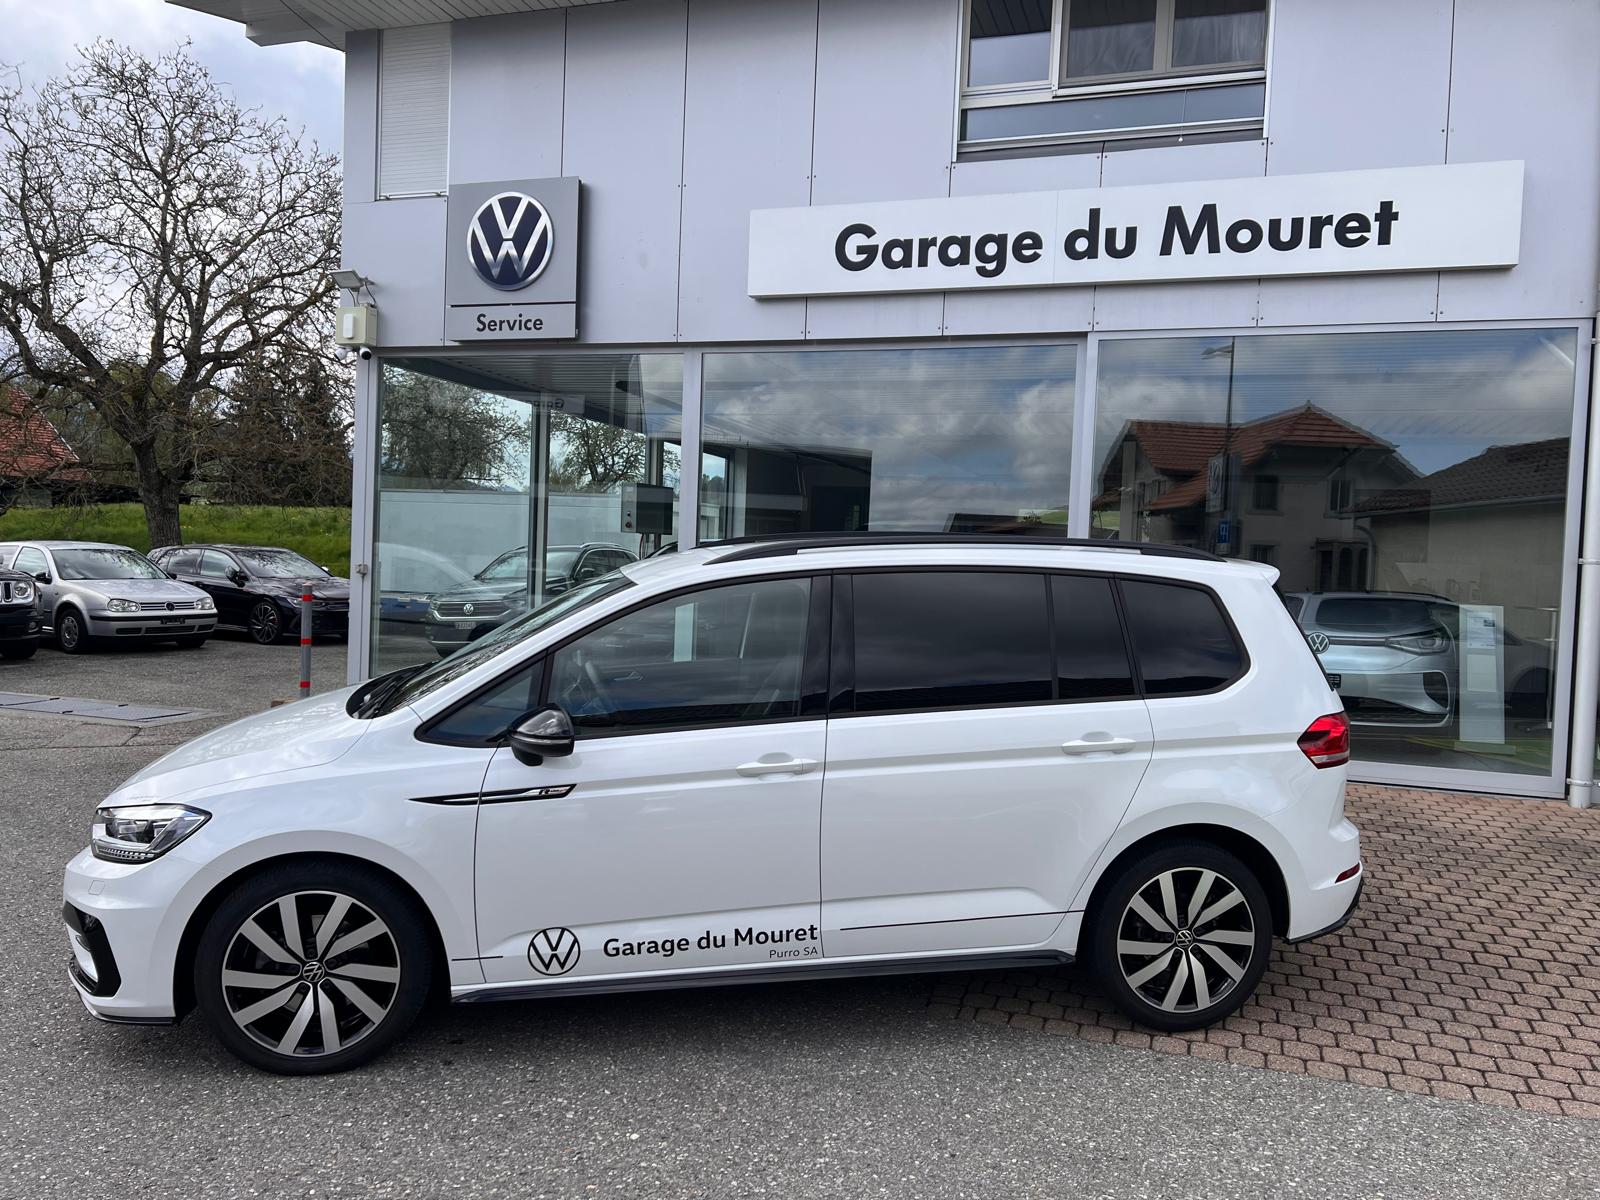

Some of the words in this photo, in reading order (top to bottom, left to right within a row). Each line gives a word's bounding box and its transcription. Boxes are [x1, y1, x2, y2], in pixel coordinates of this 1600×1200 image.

[467, 191, 554, 291] VW
[835, 222, 1043, 279] Garage
[1064, 208, 1138, 261] du
[1159, 200, 1400, 257] Mouret
[476, 313, 544, 333] Service
[1307, 632, 1330, 654] VW
[527, 926, 581, 976] VW
[603, 937, 690, 958] Garage
[697, 930, 727, 950] du
[734, 924, 819, 947] Mouret
[769, 948, 800, 959] Purro
[803, 946, 819, 956] SA
